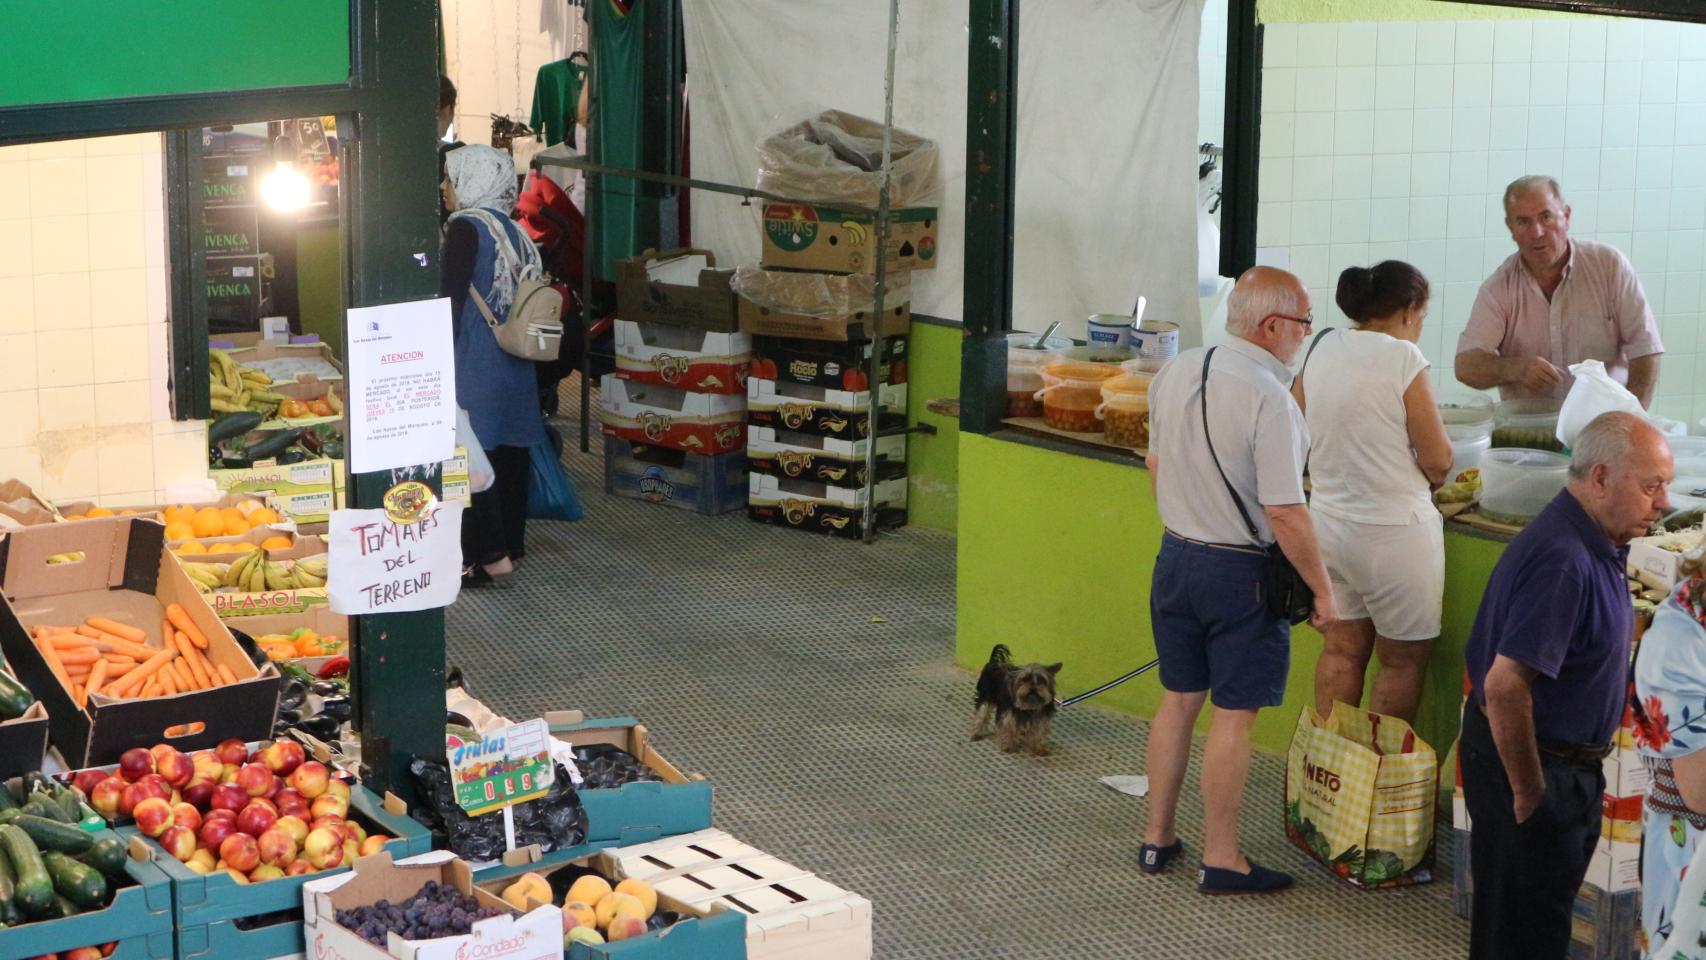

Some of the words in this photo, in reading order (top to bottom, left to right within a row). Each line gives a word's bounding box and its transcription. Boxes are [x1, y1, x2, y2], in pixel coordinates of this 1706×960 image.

[383, 550, 417, 572] DEL
[215, 591, 304, 610] BLASOL
[360, 571, 432, 609] TERRENO
[454, 735, 505, 766] frutas
[472, 936, 525, 958] Condado
